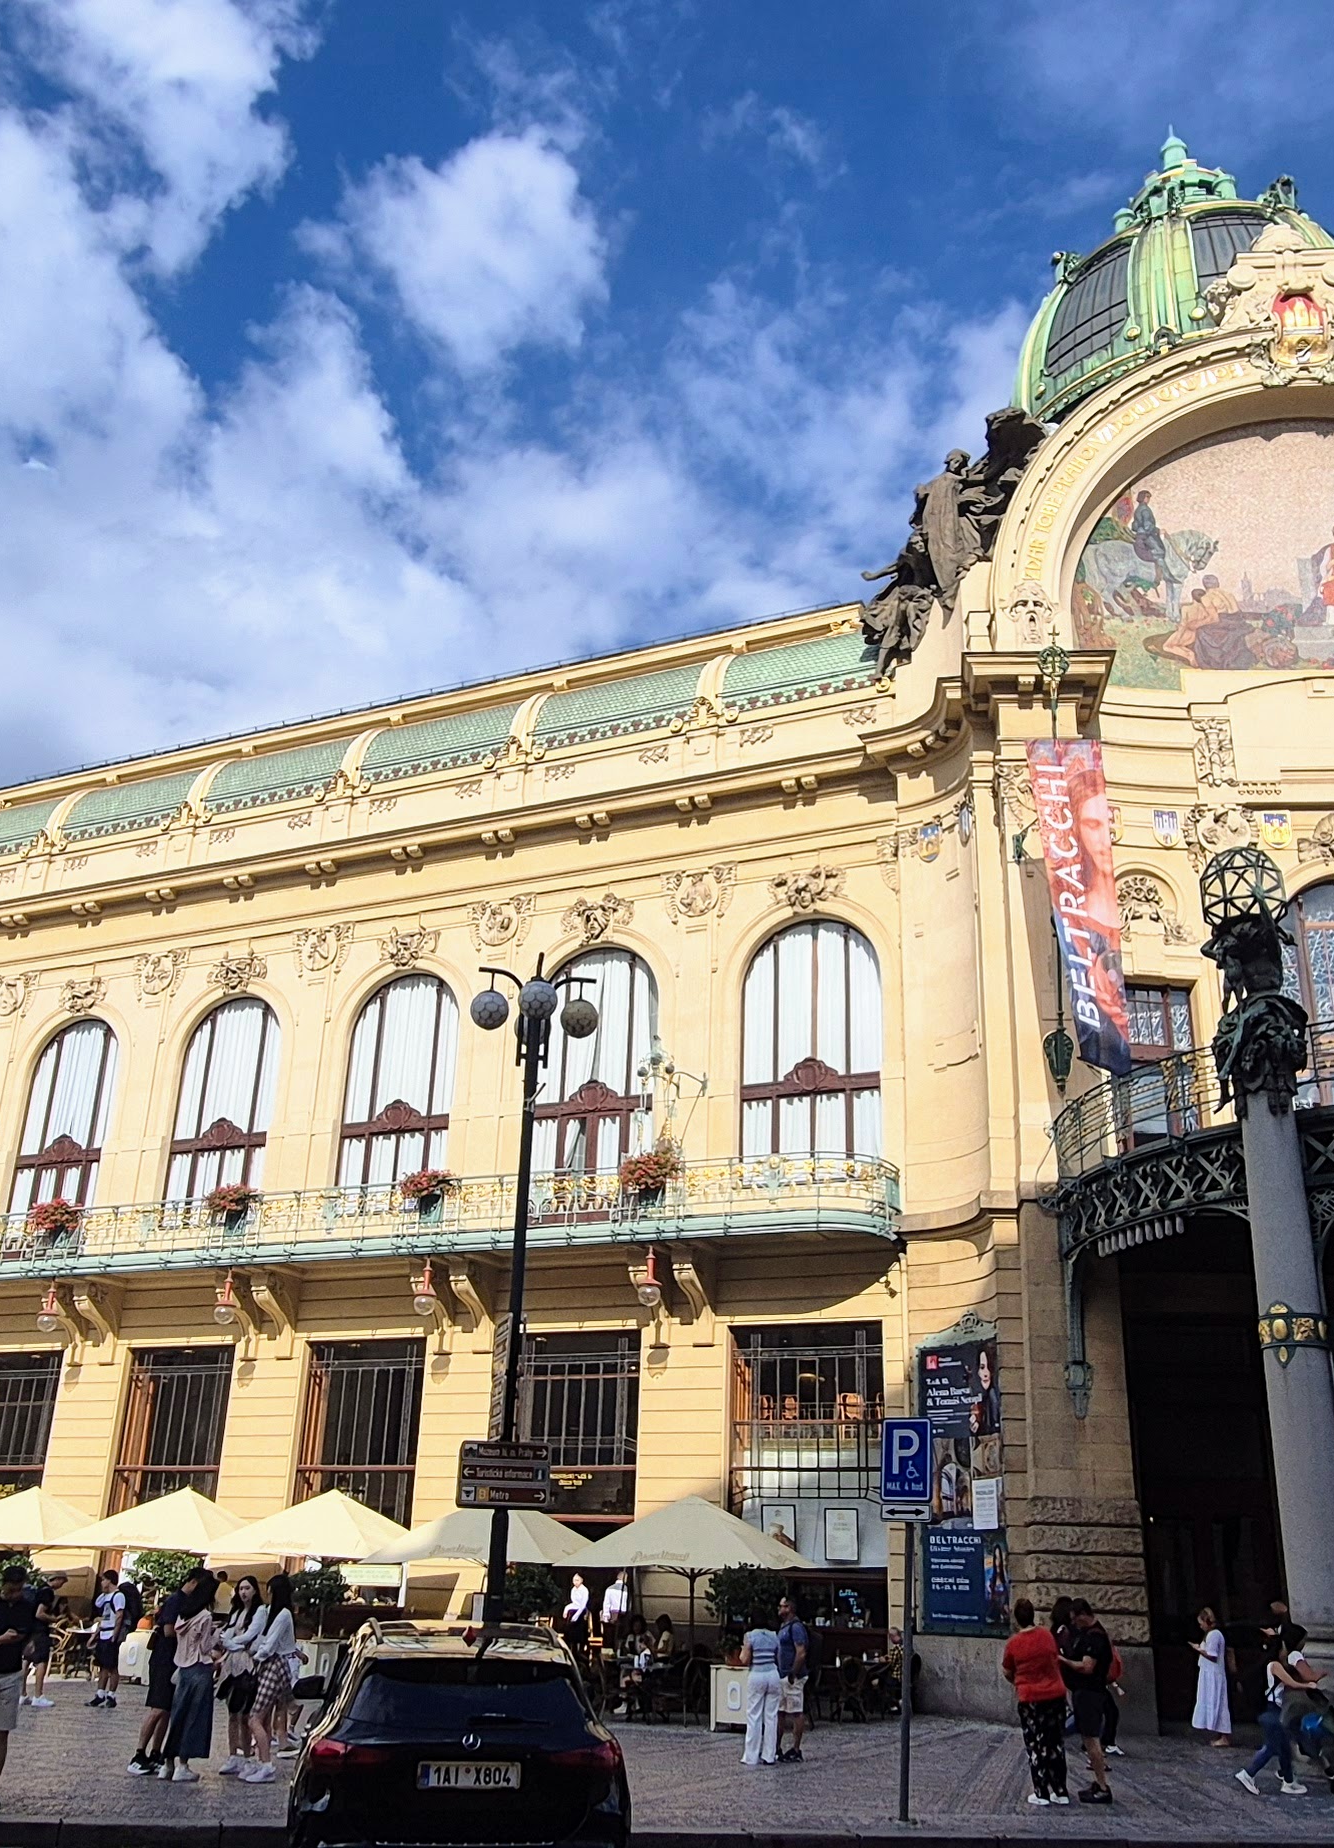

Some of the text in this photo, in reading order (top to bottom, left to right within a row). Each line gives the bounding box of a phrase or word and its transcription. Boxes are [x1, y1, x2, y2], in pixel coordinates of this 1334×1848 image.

[1034, 764, 1101, 1029] BELTRACCHI
[892, 1429, 919, 1474] P
[490, 1488, 509, 1501] Metro
[473, 1766, 511, 1786] X804
